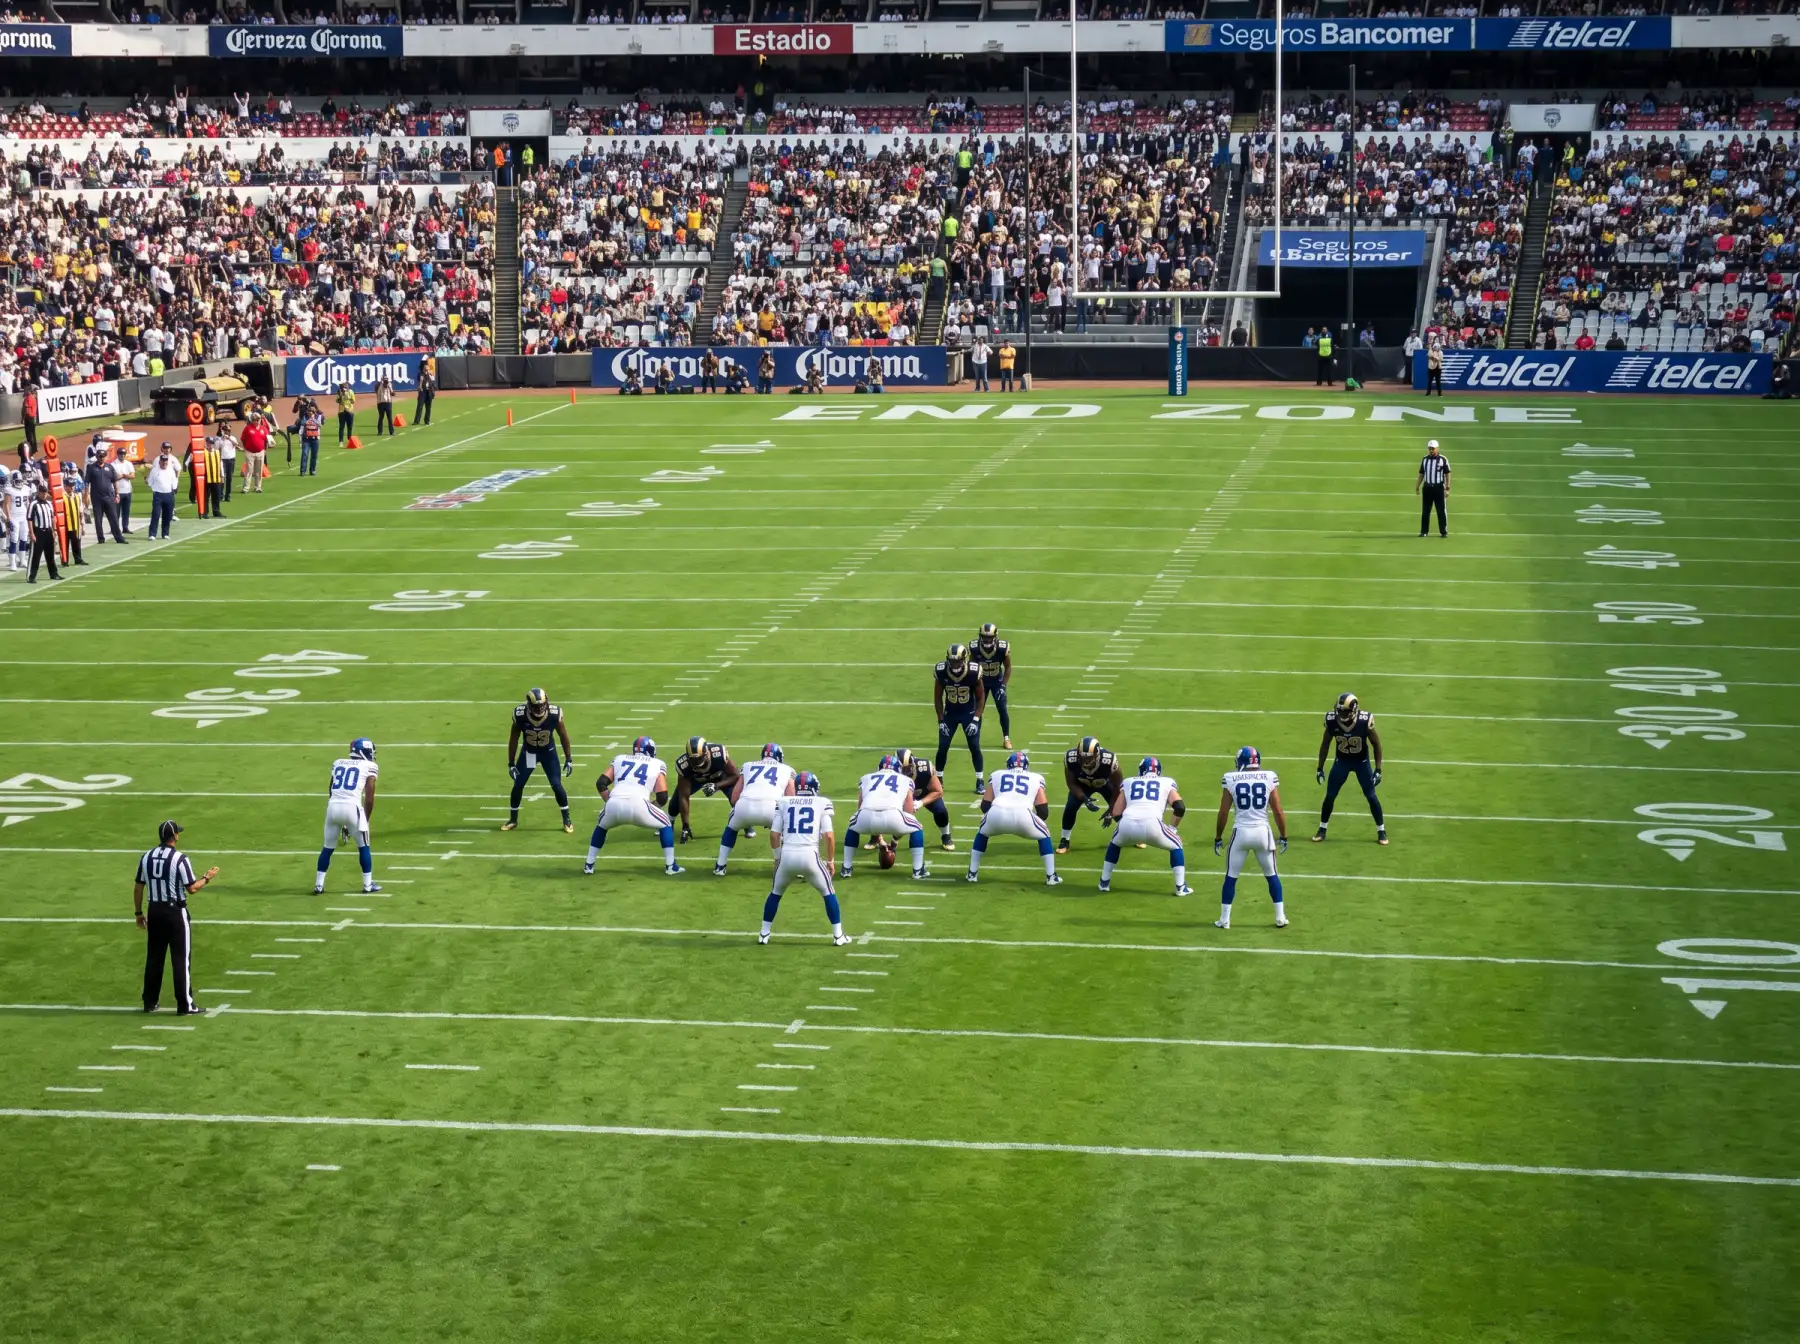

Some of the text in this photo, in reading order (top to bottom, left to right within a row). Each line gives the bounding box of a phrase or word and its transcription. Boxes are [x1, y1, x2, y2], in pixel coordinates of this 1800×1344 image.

[0, 32, 53, 50] orona
[226, 28, 383, 55] Cerveza Corona
[735, 28, 832, 51] Estadio
[1219, 22, 1454, 51] Seguros Bancomer
[1542, 20, 1637, 48] telcel
[1287, 248, 1413, 262] Bancomer
[1298, 237, 1389, 254] Seguros
[303, 357, 411, 395] Corona
[1466, 355, 1577, 387] telcel
[1647, 357, 1759, 389] telcel
[46, 391, 109, 413] VISITANTE
[770, 403, 1583, 424] END ZONE
[368, 589, 491, 612] 50
[1593, 601, 1704, 625] 50
[233, 649, 369, 678] 40
[1605, 666, 1728, 697] 40
[151, 687, 301, 719] 30
[1614, 706, 1747, 741] 30
[332, 766, 360, 791] 30
[617, 760, 649, 786] 74
[746, 765, 778, 787] 74
[869, 774, 899, 793] 74
[1000, 774, 1030, 796] 65
[0, 772, 133, 813] 20
[1235, 782, 1267, 810] 88
[787, 806, 815, 834] 12
[1633, 802, 1788, 851] 20
[152, 859, 165, 878] U
[1656, 937, 1800, 993] 10
